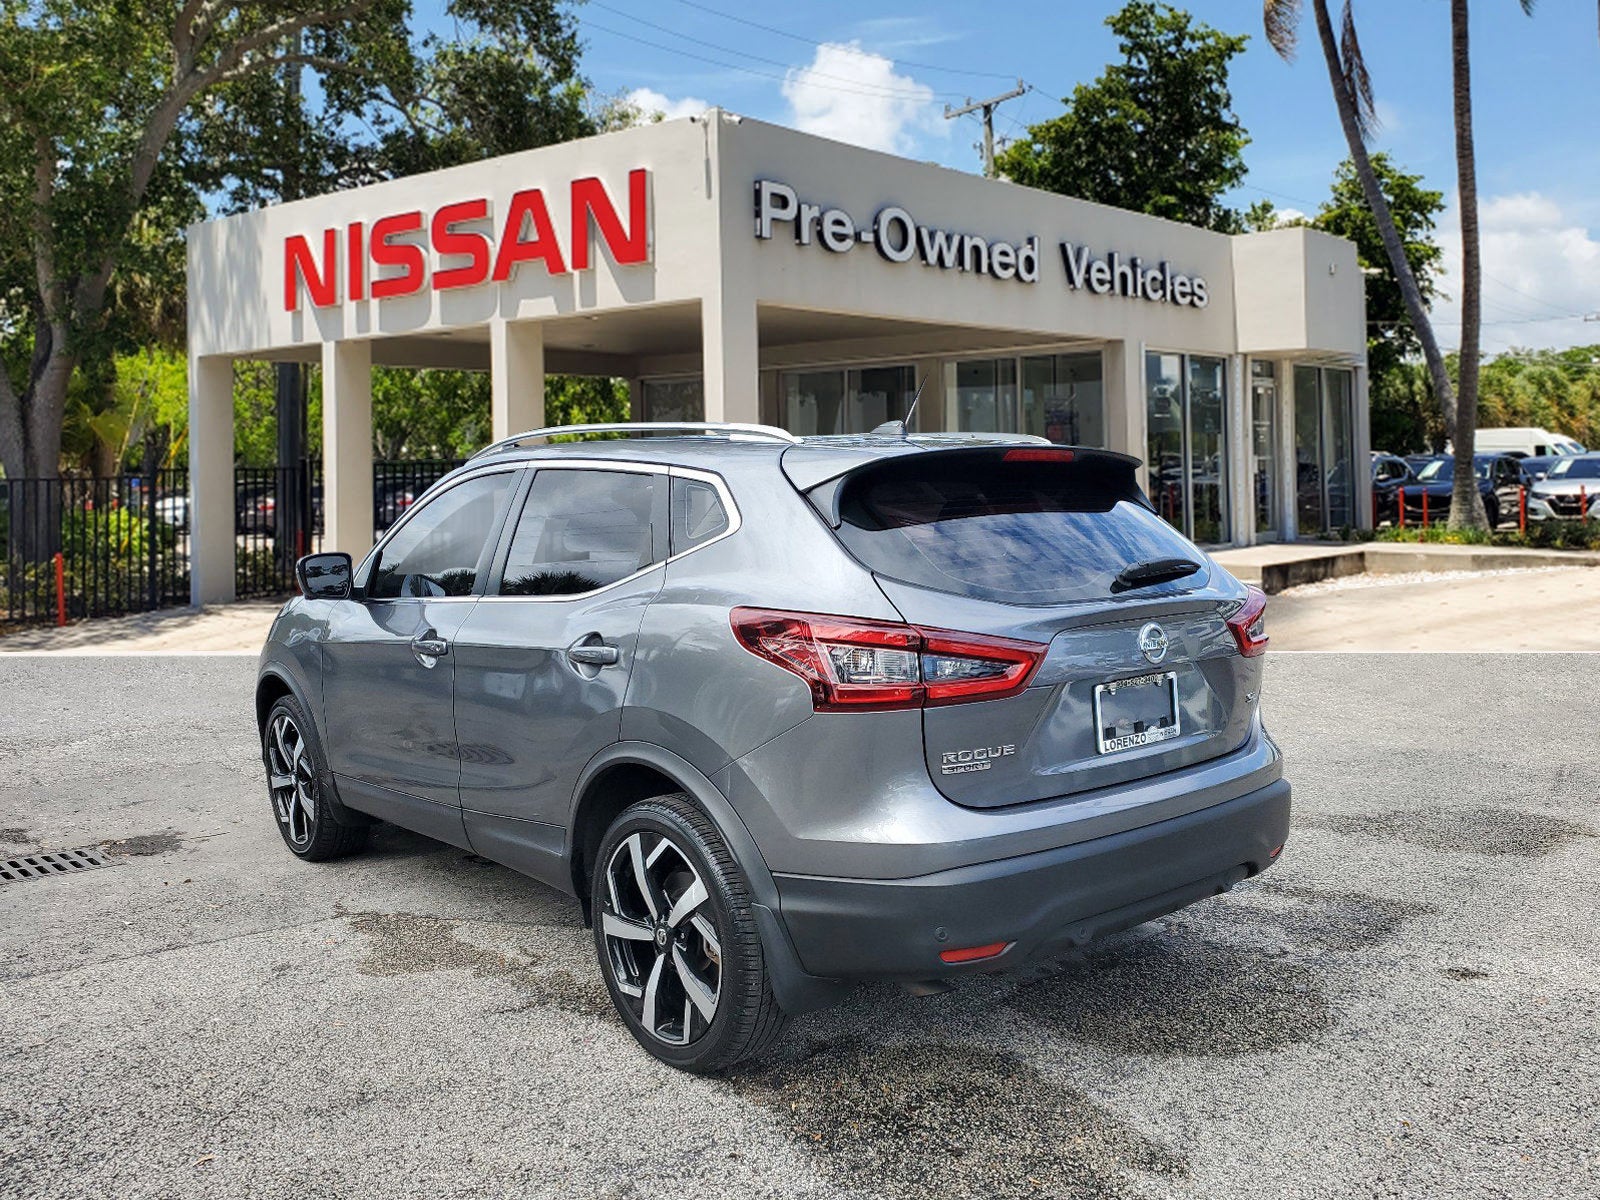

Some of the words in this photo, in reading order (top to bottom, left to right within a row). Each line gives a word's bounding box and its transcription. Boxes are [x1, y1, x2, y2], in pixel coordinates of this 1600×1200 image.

[284, 168, 648, 312] NISSAN
[754, 179, 1040, 284] Pre-Owned
[1060, 242, 1209, 308] Vehicles
[1104, 733, 1147, 752] LORENZO
[942, 744, 1016, 764] ROGUE
[943, 761, 990, 774] SPORT
